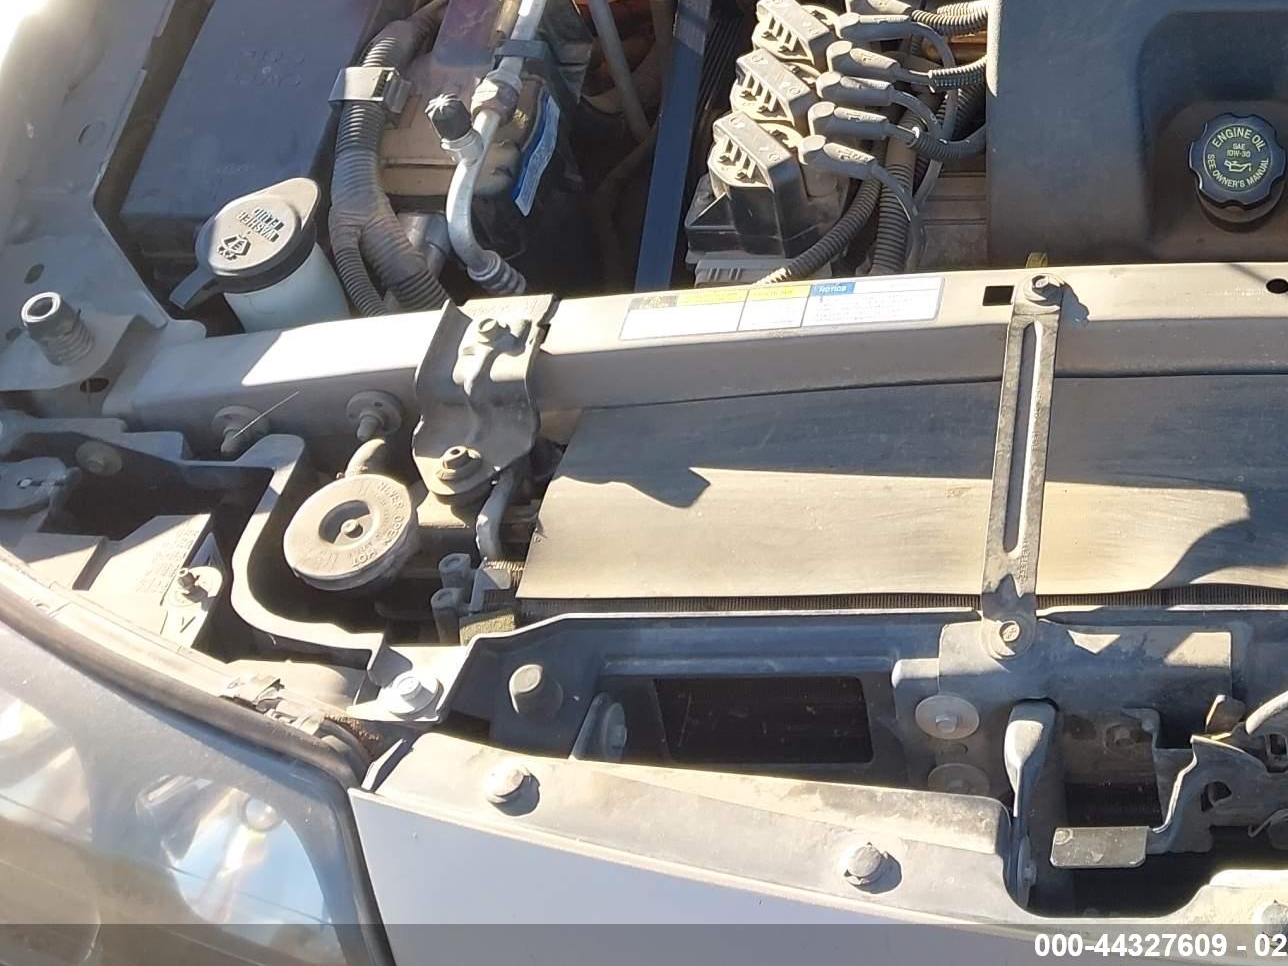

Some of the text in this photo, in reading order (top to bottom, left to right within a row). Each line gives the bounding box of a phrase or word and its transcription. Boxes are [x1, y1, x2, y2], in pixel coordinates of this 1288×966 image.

[1212, 127, 1267, 152] ENGINE OIL
[1207, 154, 1269, 188] SEE OWNER'S MANUAL
[238, 211, 280, 243] WASHER
